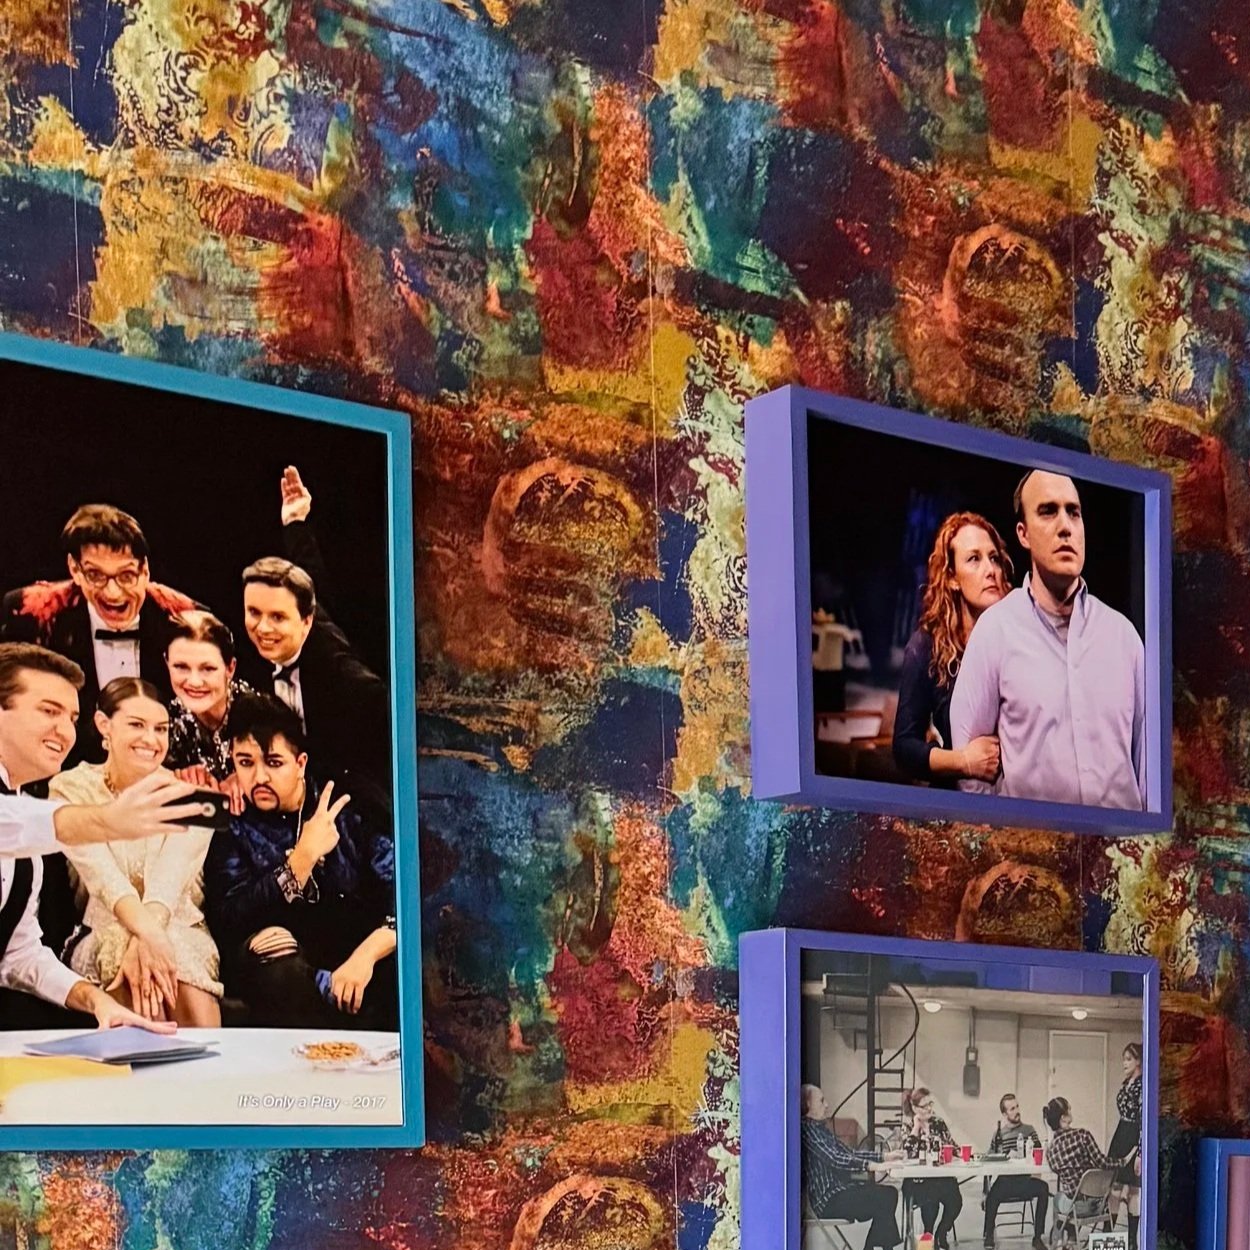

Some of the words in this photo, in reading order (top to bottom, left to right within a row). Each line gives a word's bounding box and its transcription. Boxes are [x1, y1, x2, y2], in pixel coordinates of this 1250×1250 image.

[238, 1095, 259, 1107] It's
[262, 1095, 296, 1110] Only
[296, 1098, 306, 1108] a
[311, 1095, 341, 1110] Play
[353, 1096, 387, 1109] 2017
